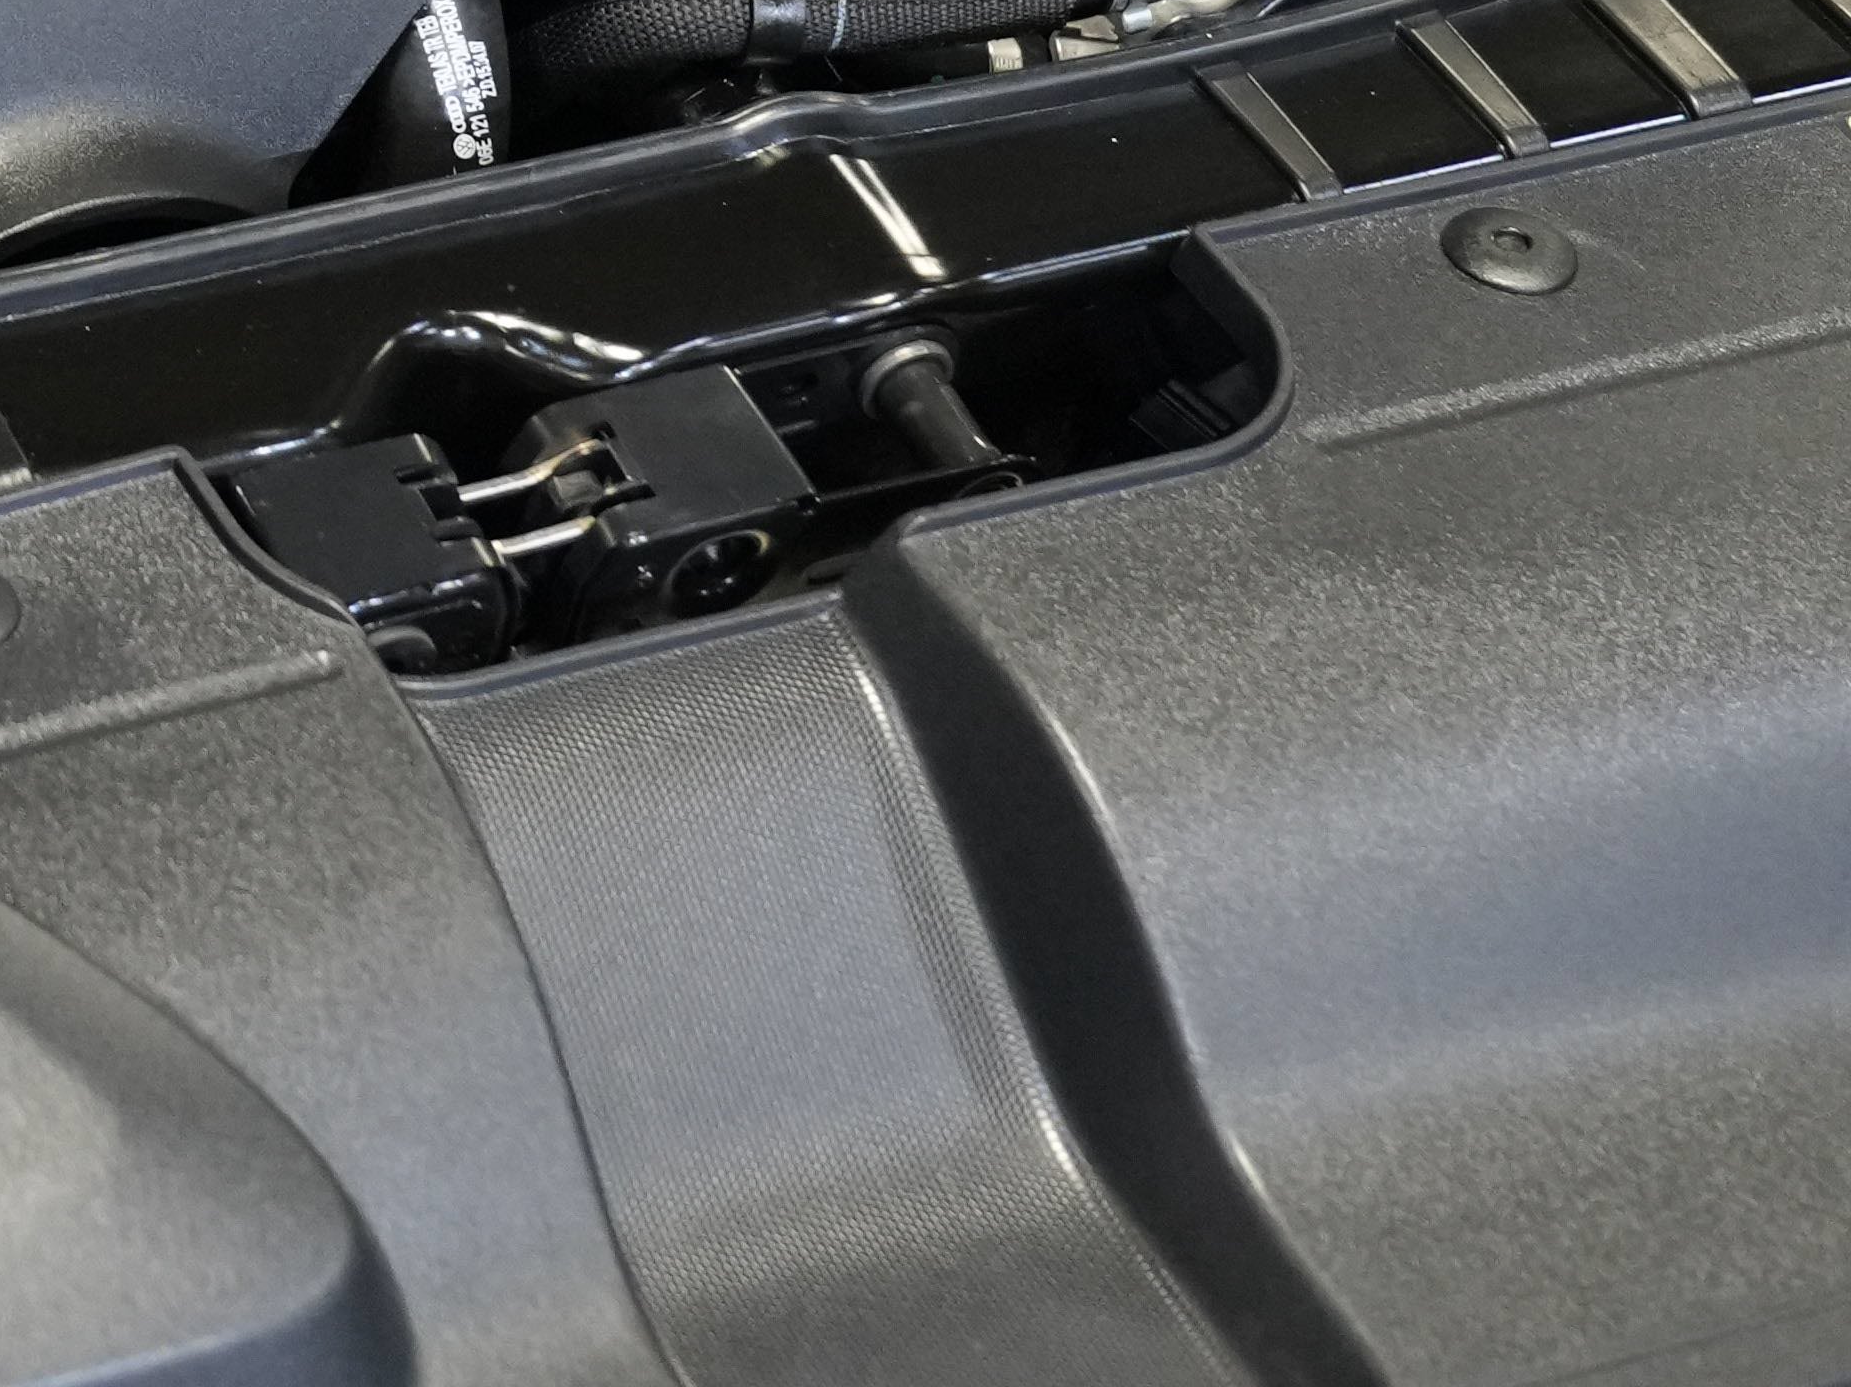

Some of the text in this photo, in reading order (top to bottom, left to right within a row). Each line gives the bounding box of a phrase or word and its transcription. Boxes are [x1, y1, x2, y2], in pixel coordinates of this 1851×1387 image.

[428, 51, 457, 96] TEKLAS
[469, 114, 489, 138] 121
[476, 137, 495, 166] 06E
